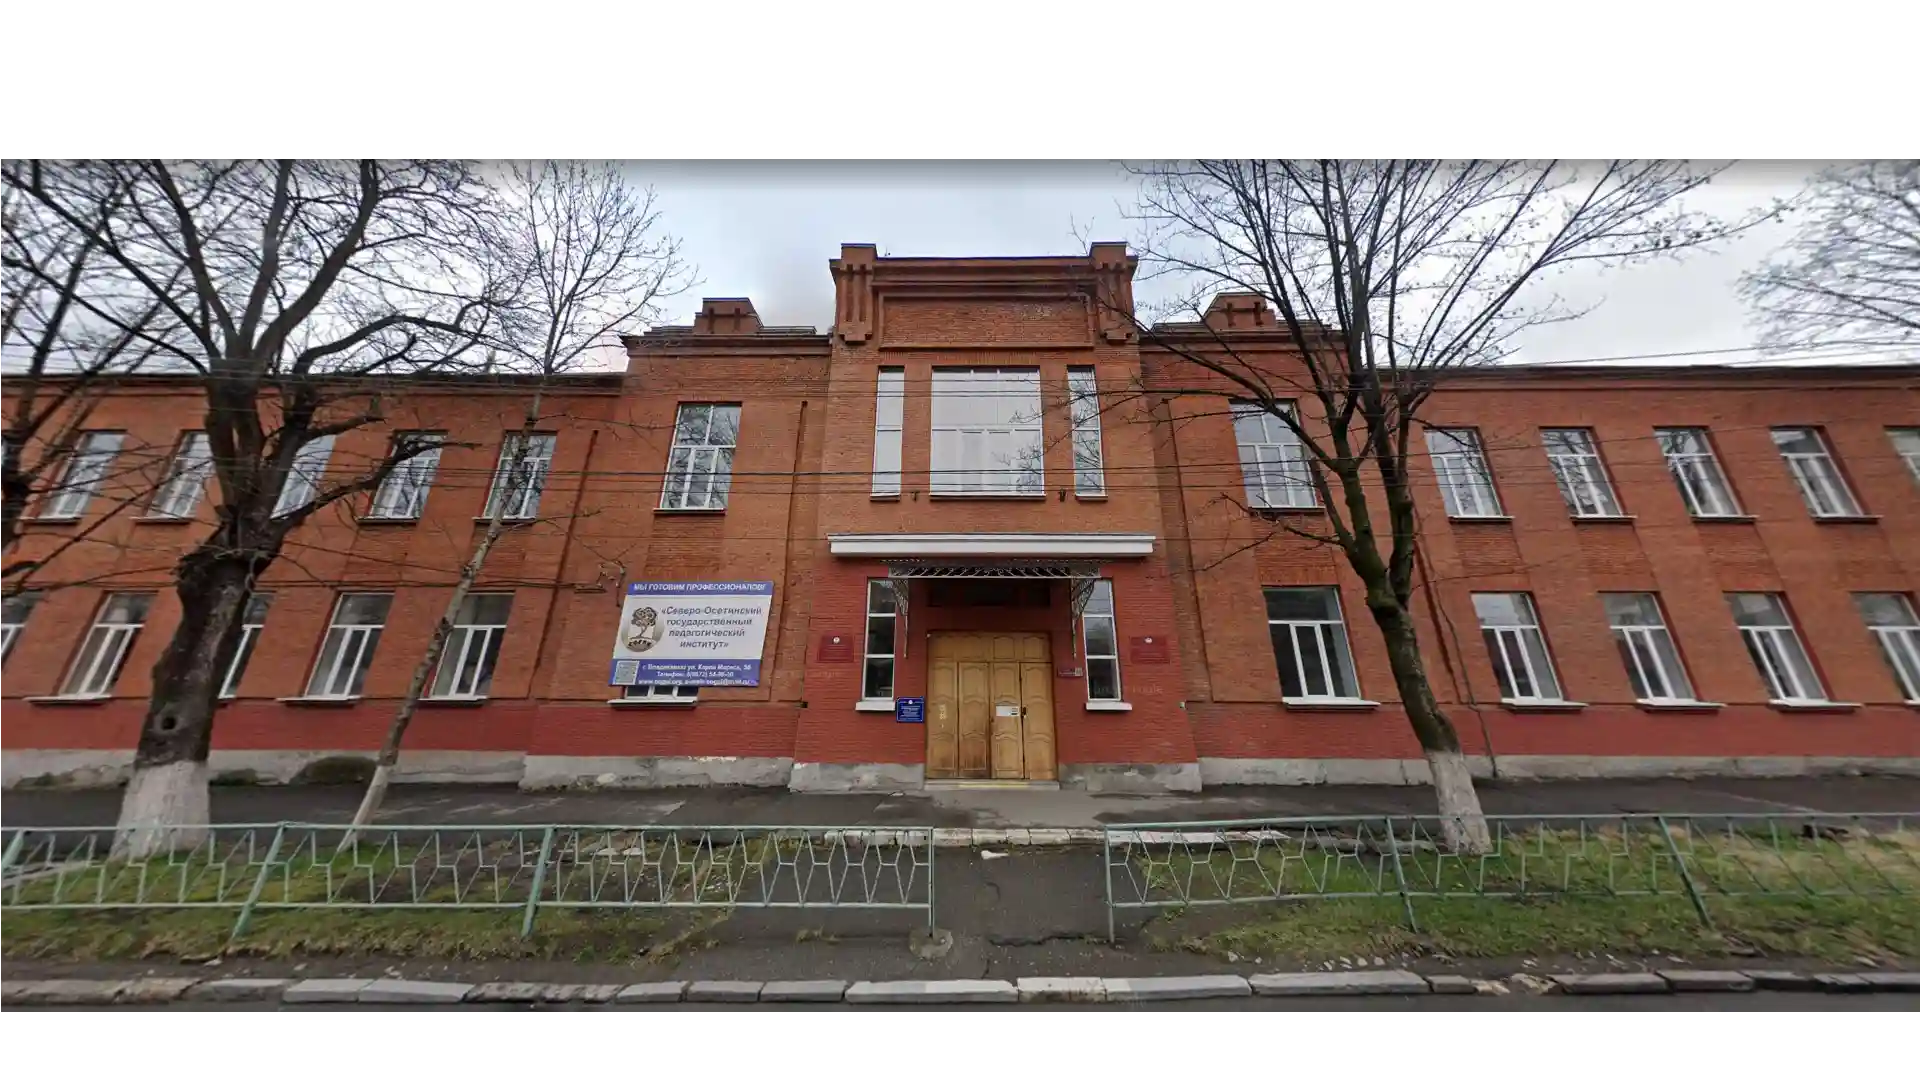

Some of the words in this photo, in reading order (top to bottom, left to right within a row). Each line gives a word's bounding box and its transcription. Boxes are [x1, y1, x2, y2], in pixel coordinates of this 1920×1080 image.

[634, 583, 647, 591] МЫ
[648, 583, 685, 591] ГОТОВИМ
[686, 583, 766, 591] ПРОФЕССИОНАЛОВ!
[661, 606, 762, 616] «Северо-Осетинский
[666, 618, 753, 628] государственный
[668, 627, 745, 638] педагогический
[680, 641, 729, 651] институт»
